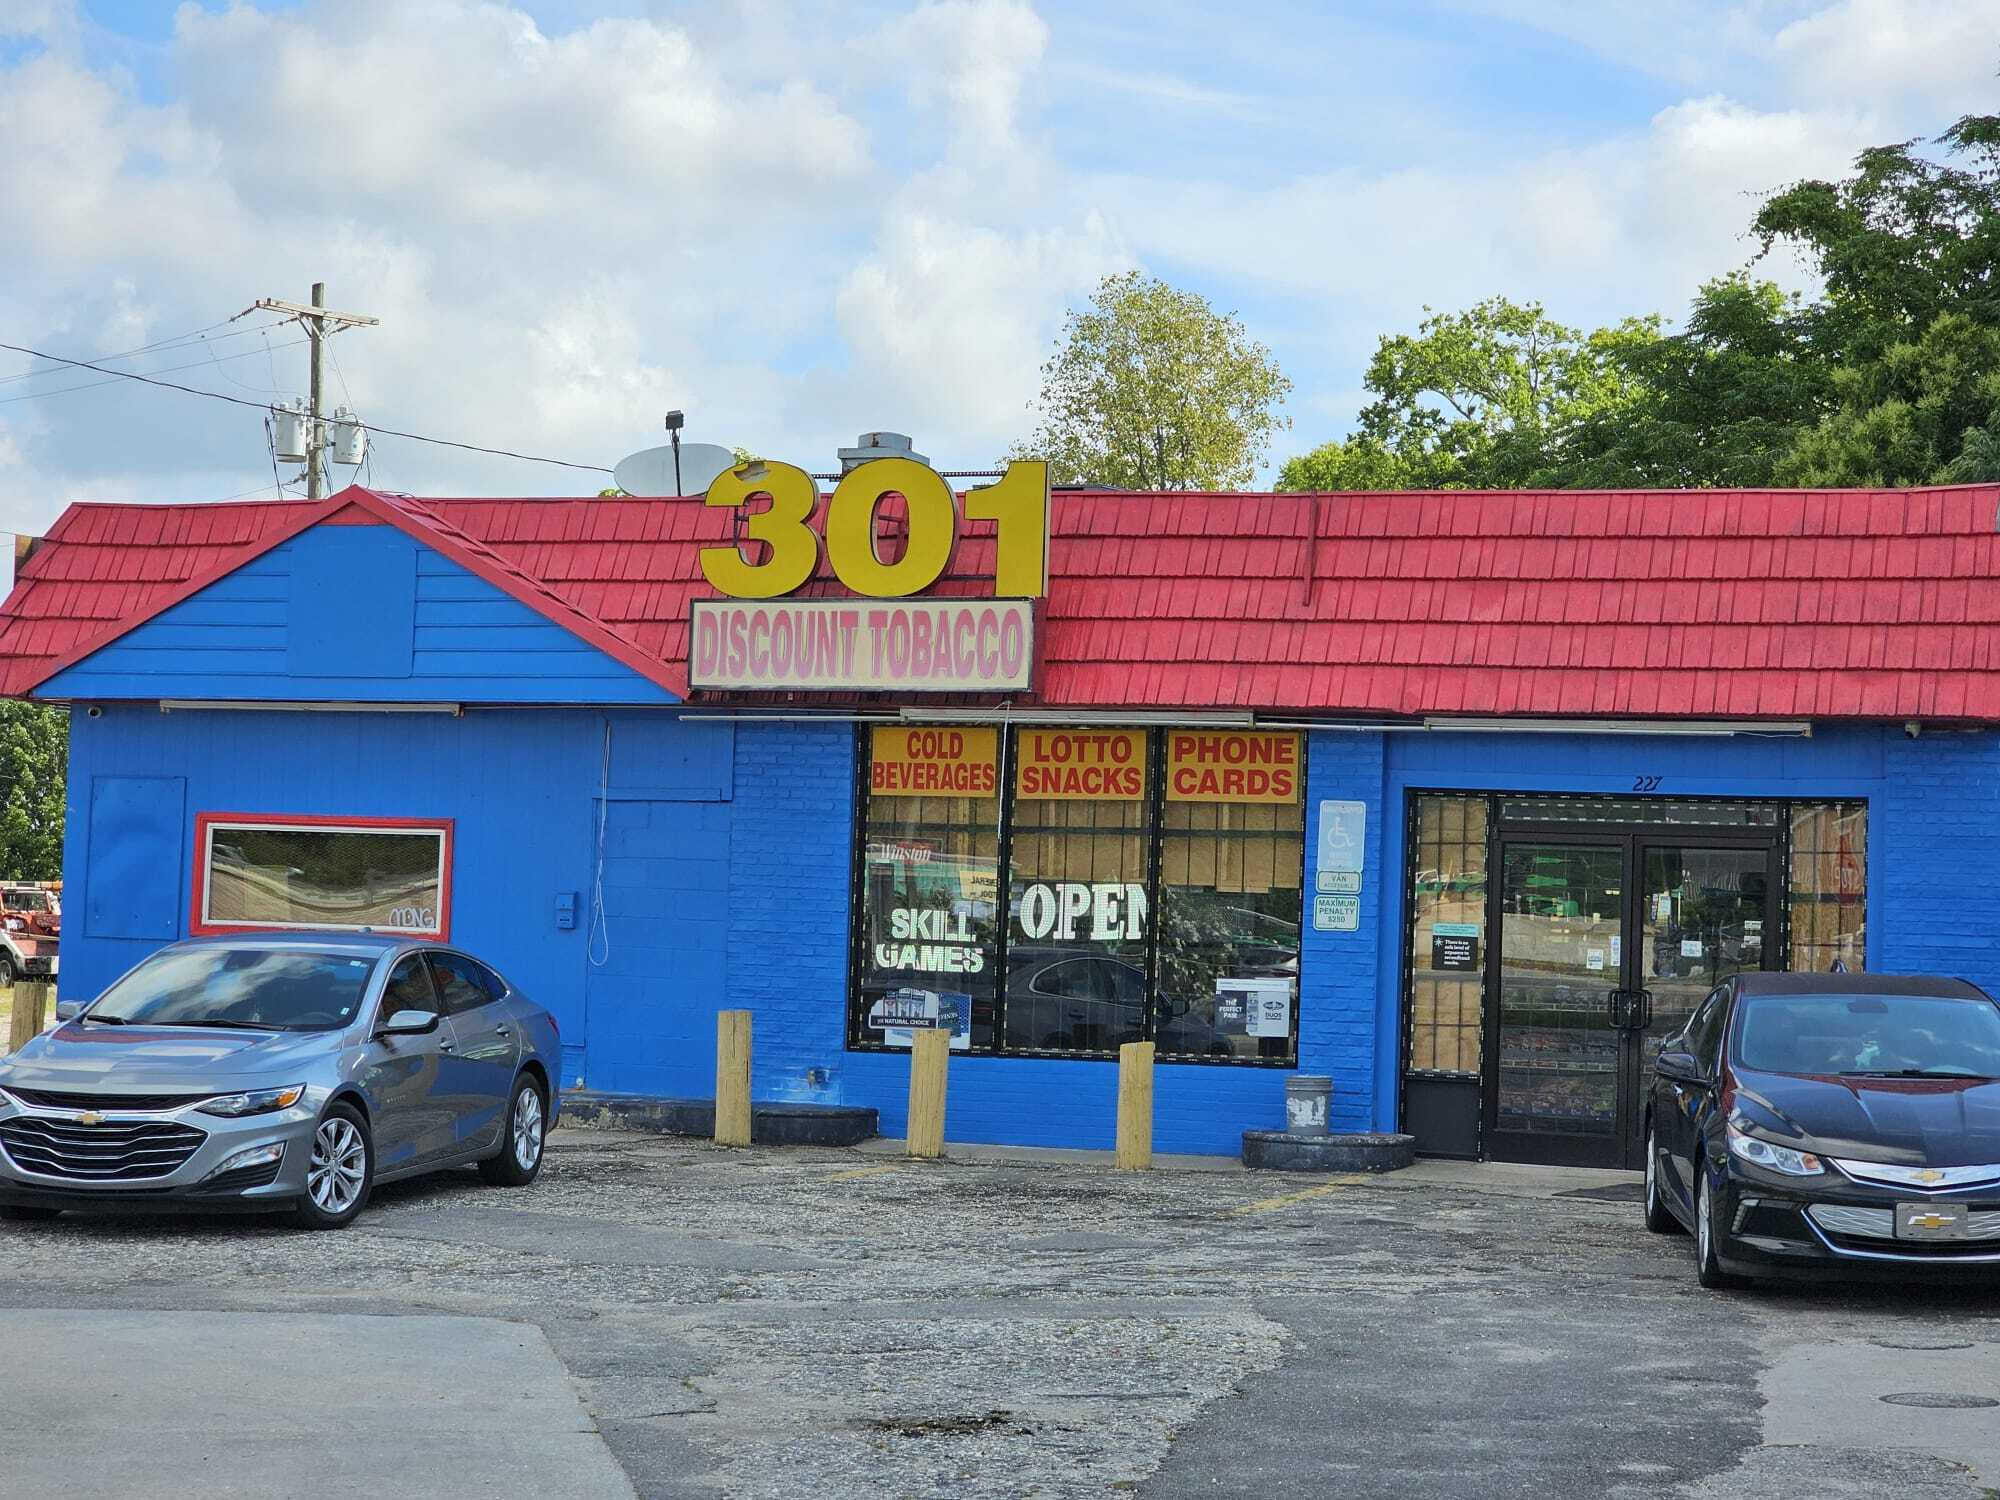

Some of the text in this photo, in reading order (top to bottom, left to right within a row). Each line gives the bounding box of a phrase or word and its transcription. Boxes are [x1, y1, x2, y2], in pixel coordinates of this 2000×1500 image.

[700, 457, 1048, 598] 301
[696, 608, 1024, 680] DISCOUNT TOBACCO
[906, 731, 964, 760] COLD
[1034, 735, 1133, 763] LOTTO
[1173, 735, 1295, 765] PHONE
[871, 762, 995, 791] BEVERAGES
[1021, 767, 1142, 795] SNACKS
[1172, 768, 1293, 796] CARDS
[1632, 775, 1664, 792] 227
[880, 843, 932, 861] Winston
[1019, 882, 1148, 940] OPEN
[1318, 899, 1356, 907] MAXIMUM
[1319, 907, 1355, 915] PENALTY
[890, 908, 977, 942] SKILL
[875, 942, 984, 973] GAMES
